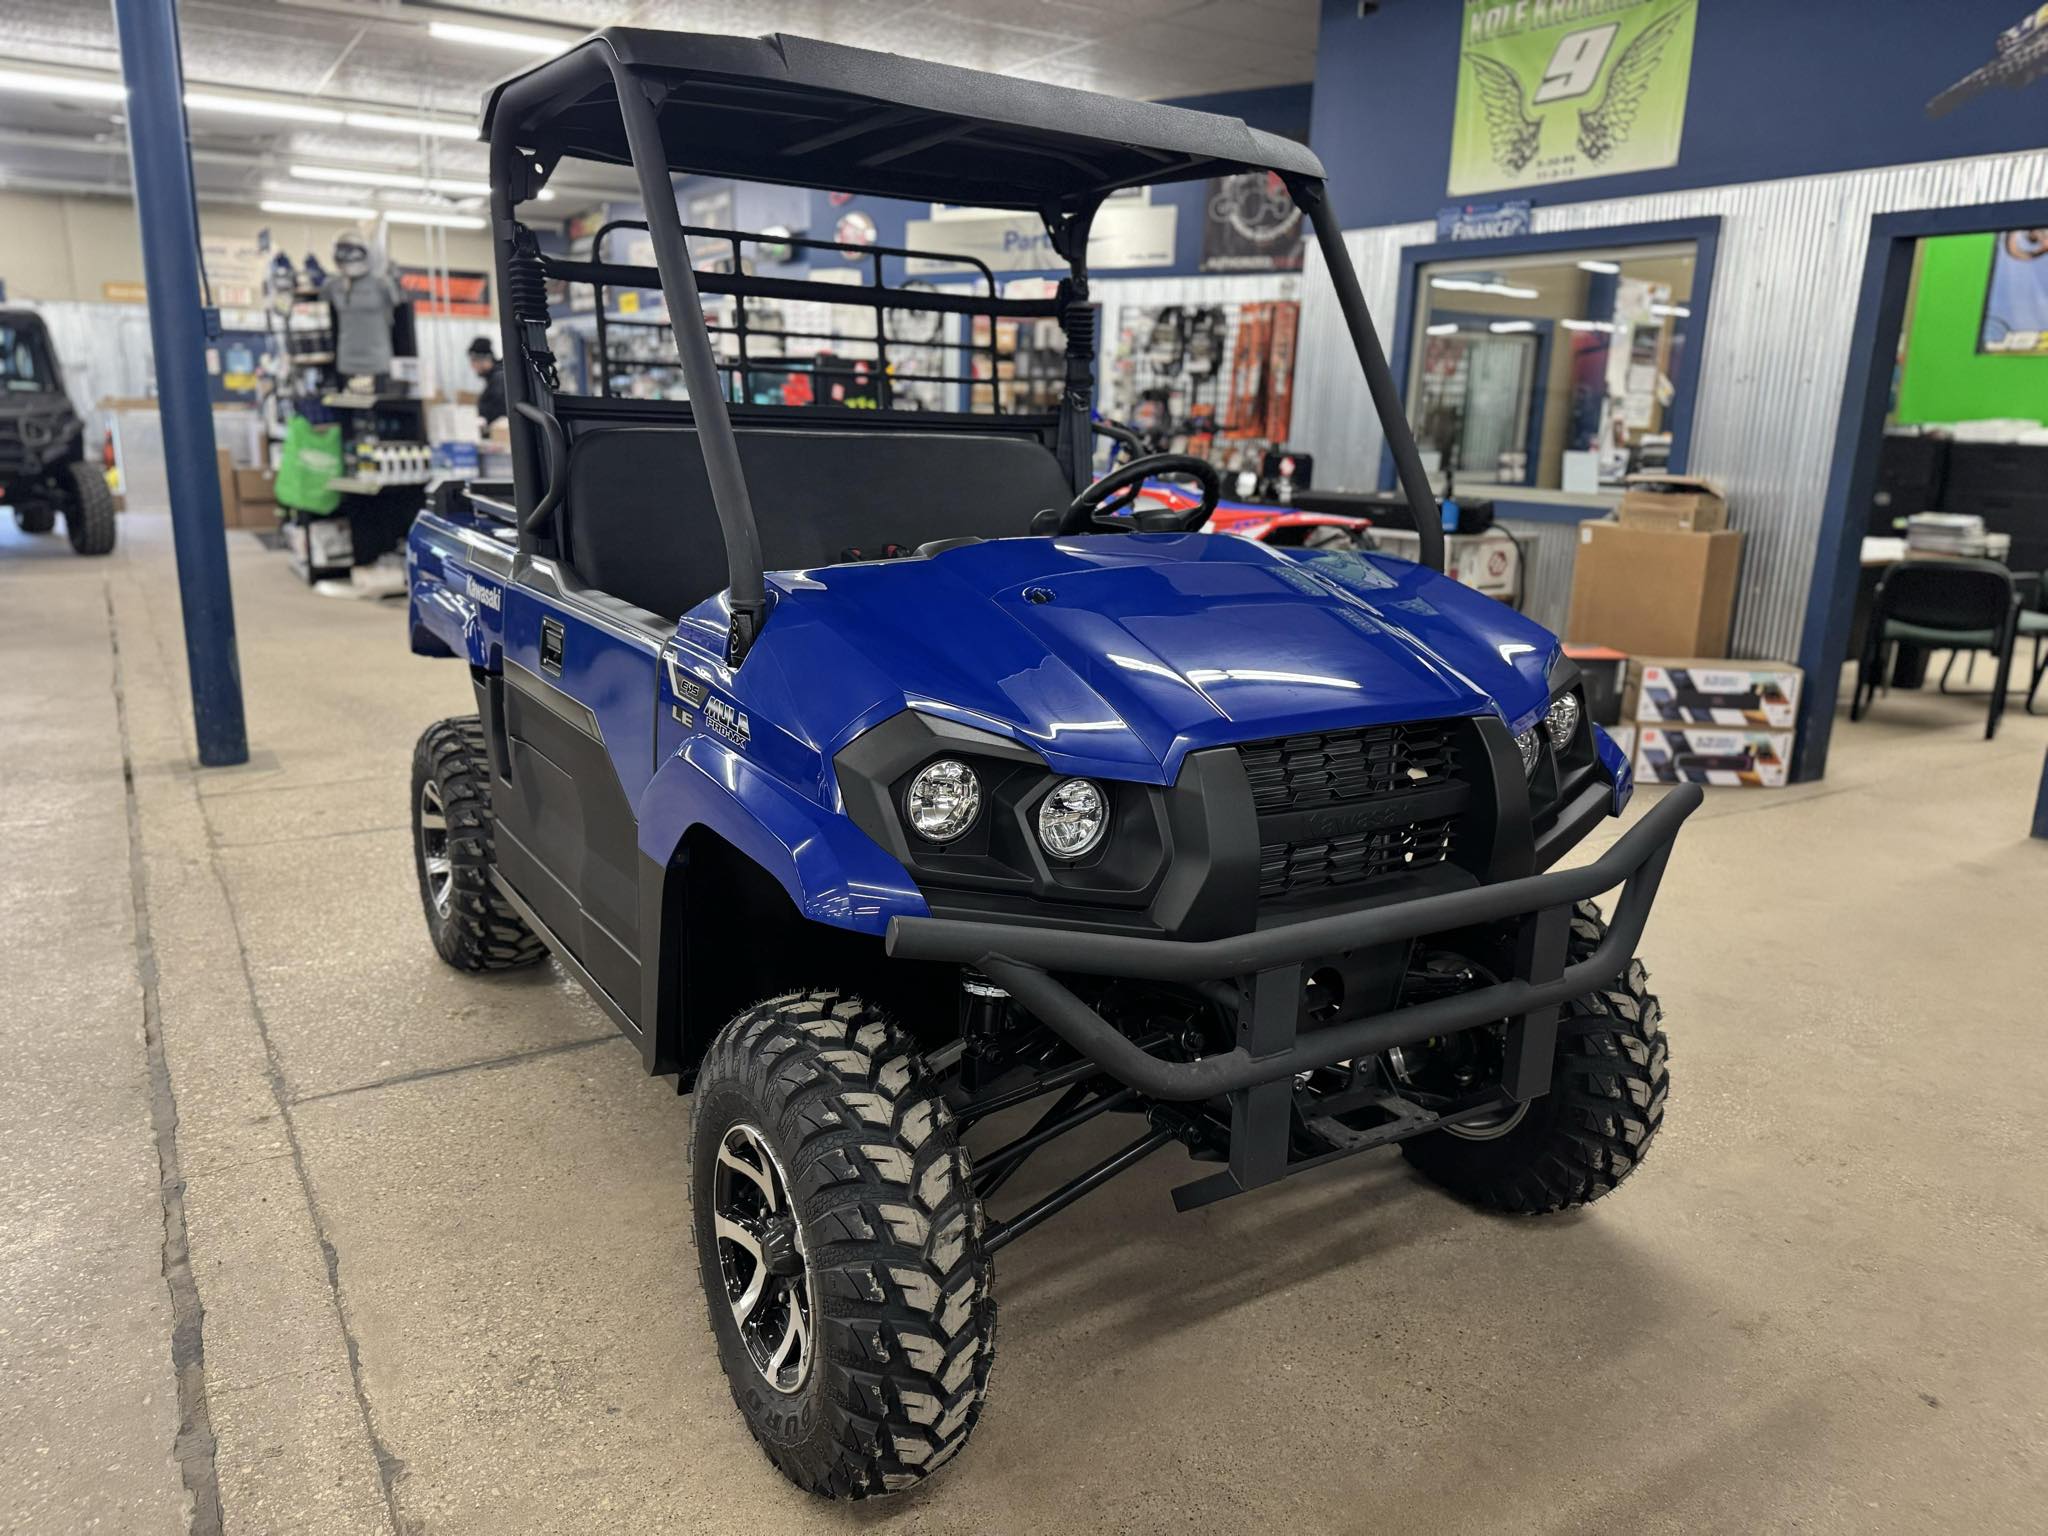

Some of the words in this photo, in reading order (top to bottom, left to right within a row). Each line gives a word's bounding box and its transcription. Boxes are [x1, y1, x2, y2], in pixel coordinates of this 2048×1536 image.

[1532, 22, 1621, 106] 9
[1003, 230, 1052, 252] Part
[466, 573, 501, 612] Kawasaki
[681, 680, 699, 696] EPS
[672, 703, 694, 729] LE
[706, 716, 747, 751] PRO-MX
